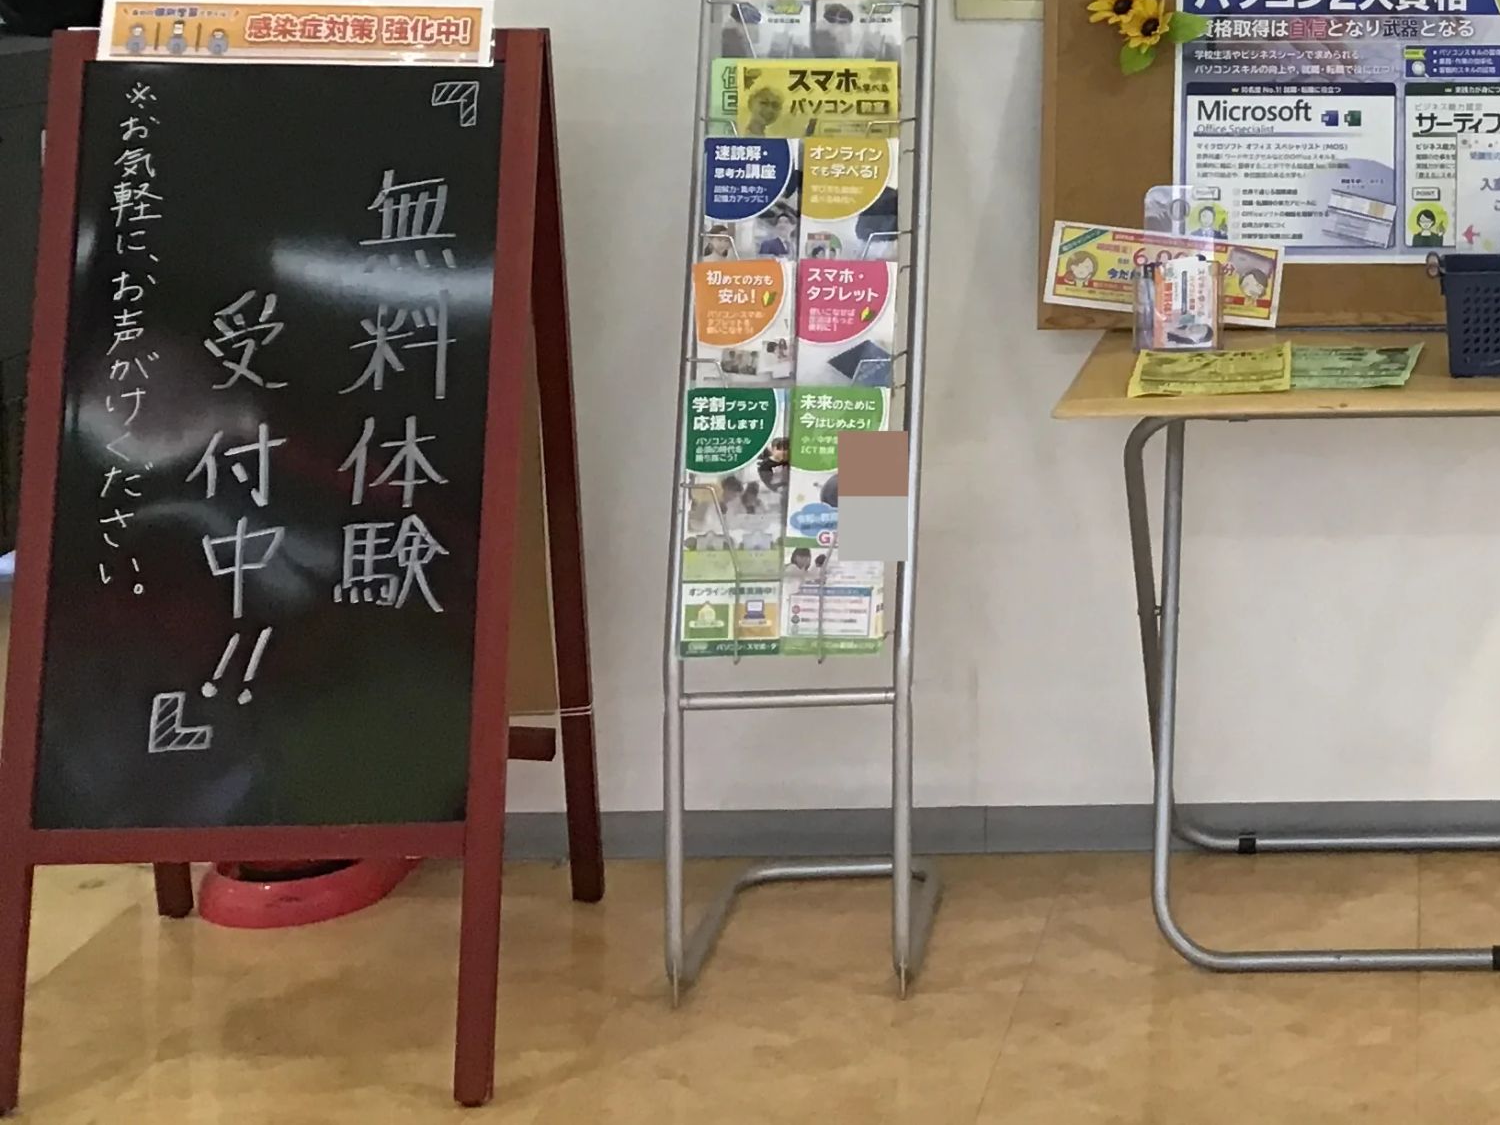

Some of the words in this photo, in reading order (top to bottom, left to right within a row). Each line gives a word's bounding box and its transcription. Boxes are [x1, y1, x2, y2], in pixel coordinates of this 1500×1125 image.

[246, 14, 377, 44] 感染症対策
[382, 13, 472, 44] 強化中!
[1197, 99, 1312, 122] Microsoft
[809, 146, 883, 162] オンライン
[714, 164, 776, 180] 思考力講座
[810, 164, 879, 179] でも学べる!
[706, 270, 774, 286] 初めての方も
[718, 288, 757, 304] 安心!
[807, 286, 879, 302] タブレット
[334, 169, 457, 613] 無料体験
[692, 396, 769, 413] 学割プランで
[800, 394, 876, 411] 未来のために
[693, 415, 764, 431] 応援します!
[800, 412, 871, 429] 今はじめよう!
